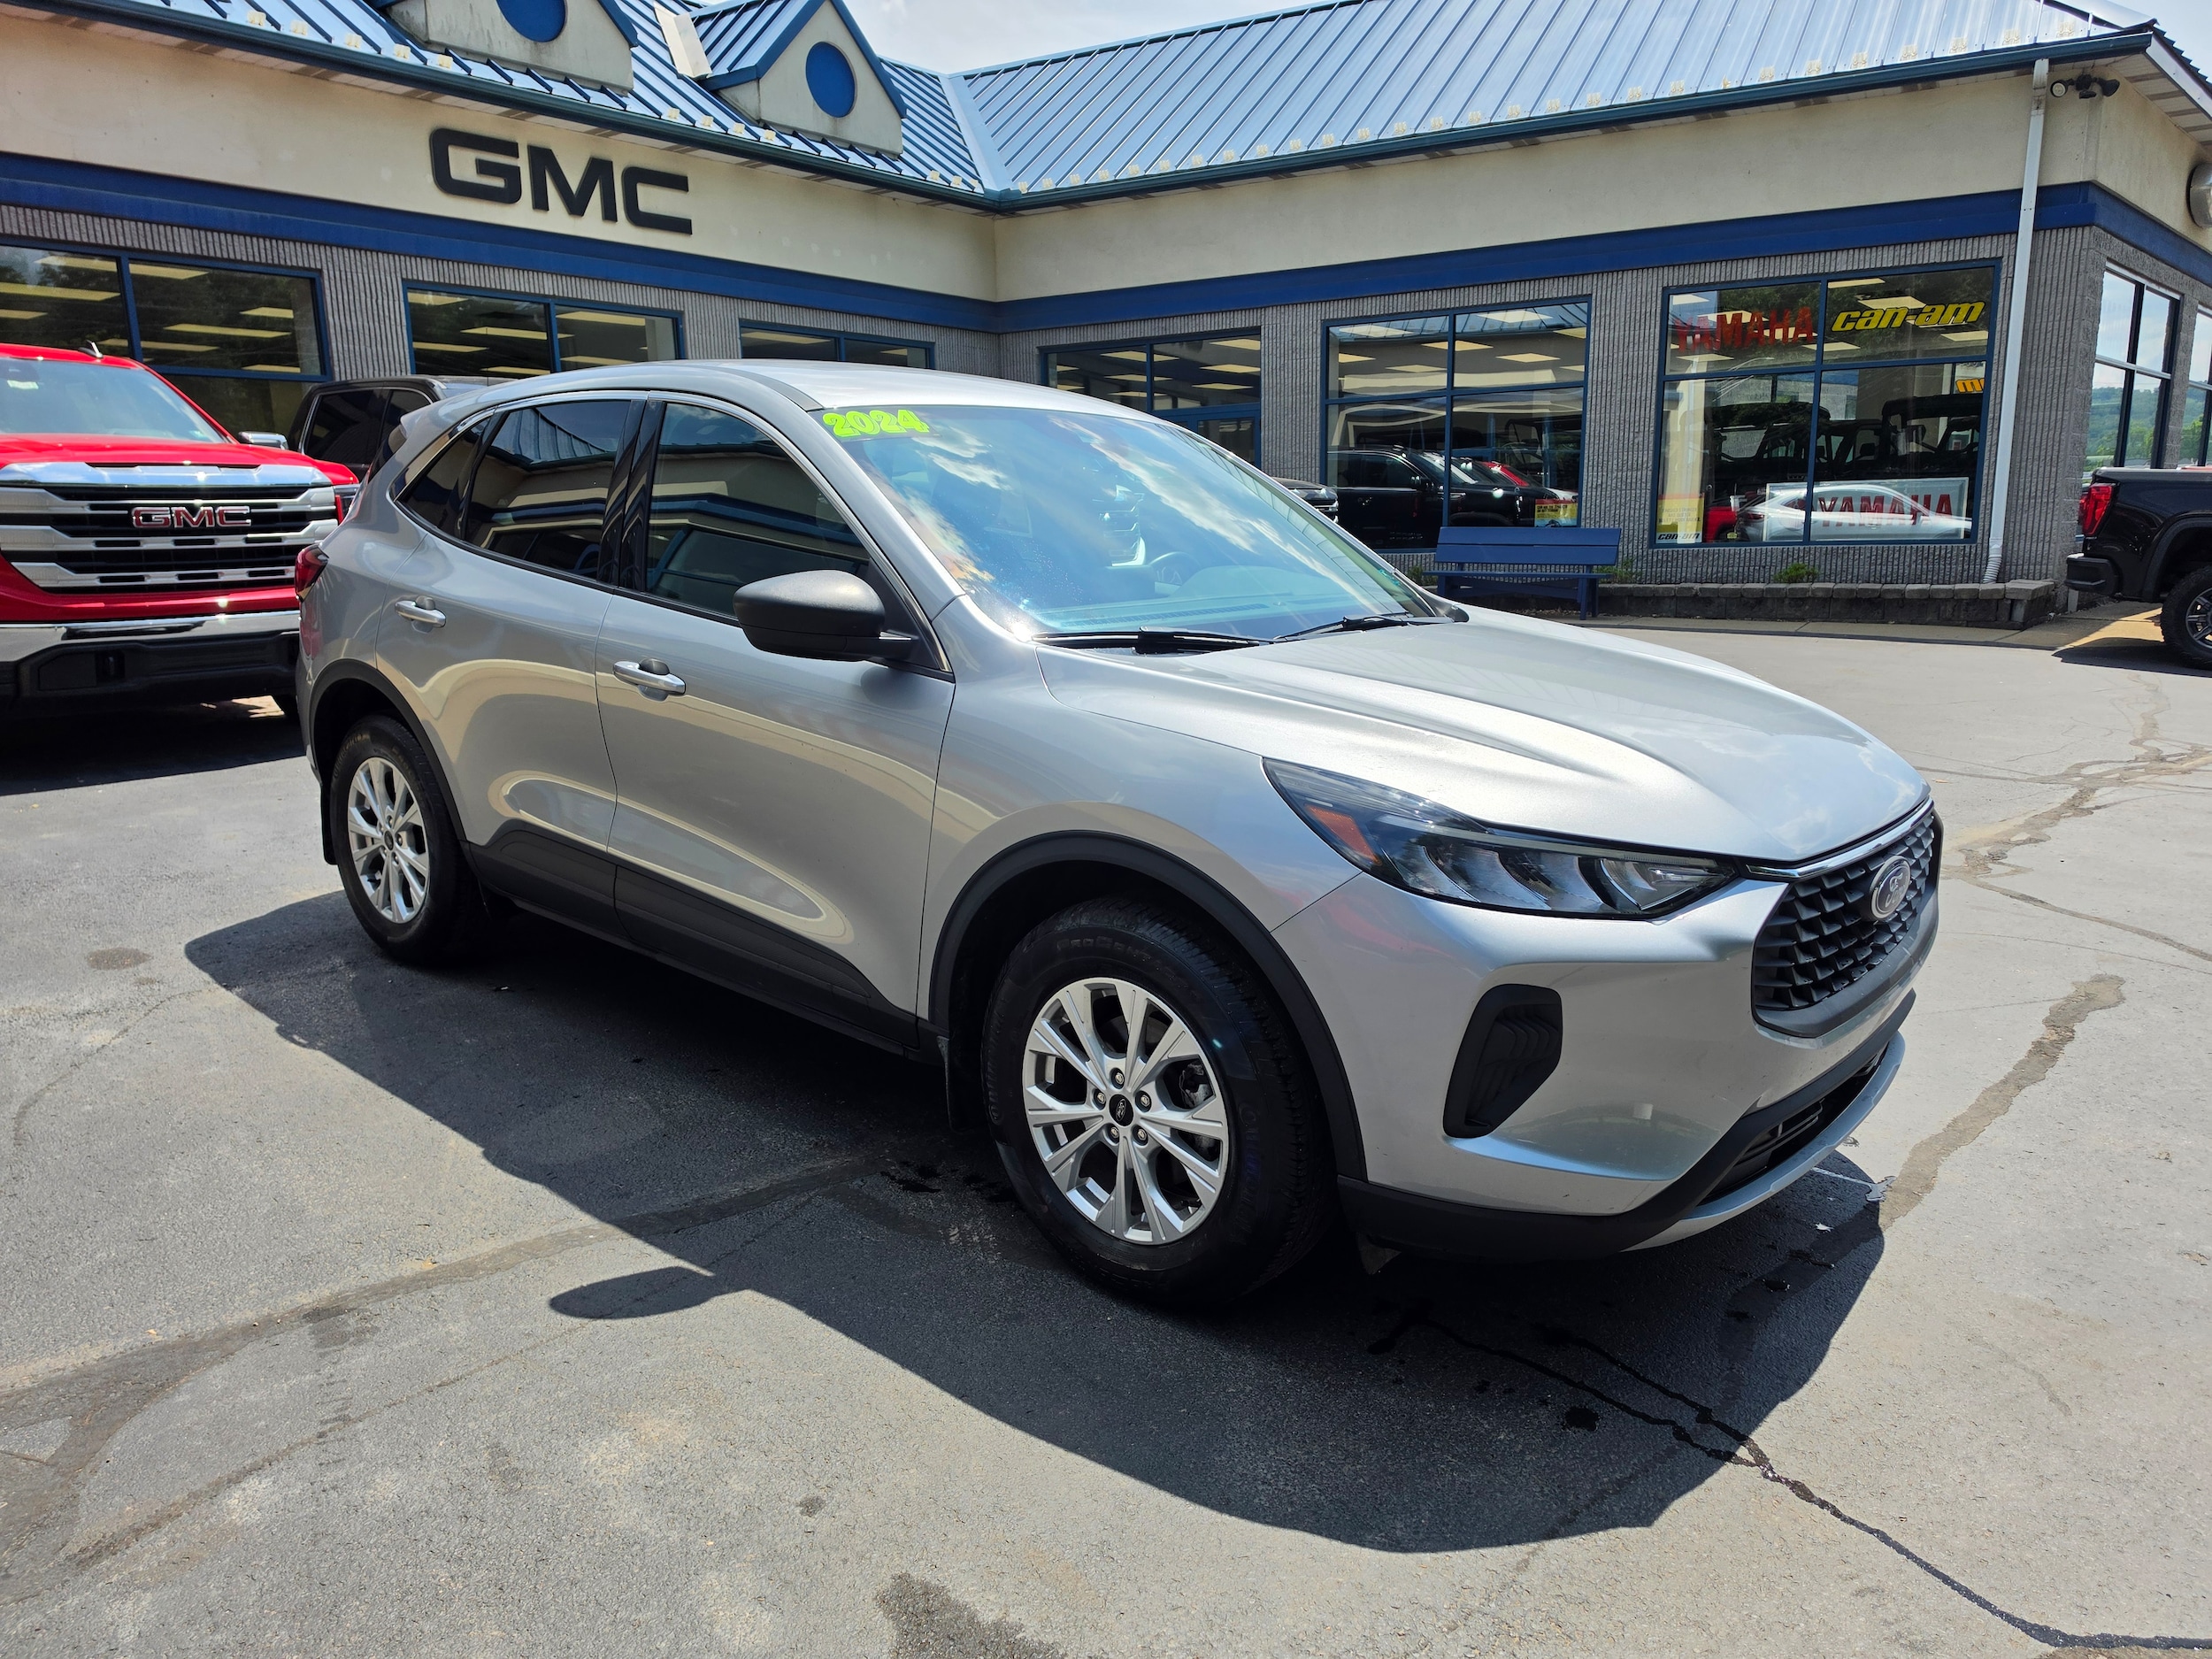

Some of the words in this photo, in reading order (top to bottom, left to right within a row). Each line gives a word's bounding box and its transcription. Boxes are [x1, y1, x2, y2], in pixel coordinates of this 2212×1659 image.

[428, 127, 693, 235] GMC
[1671, 305, 1815, 354] YAMAHA
[1832, 301, 1985, 332] can-am
[822, 409, 930, 438] 2024
[132, 505, 252, 529] GMC
[1818, 493, 1953, 528] YAMAHA
